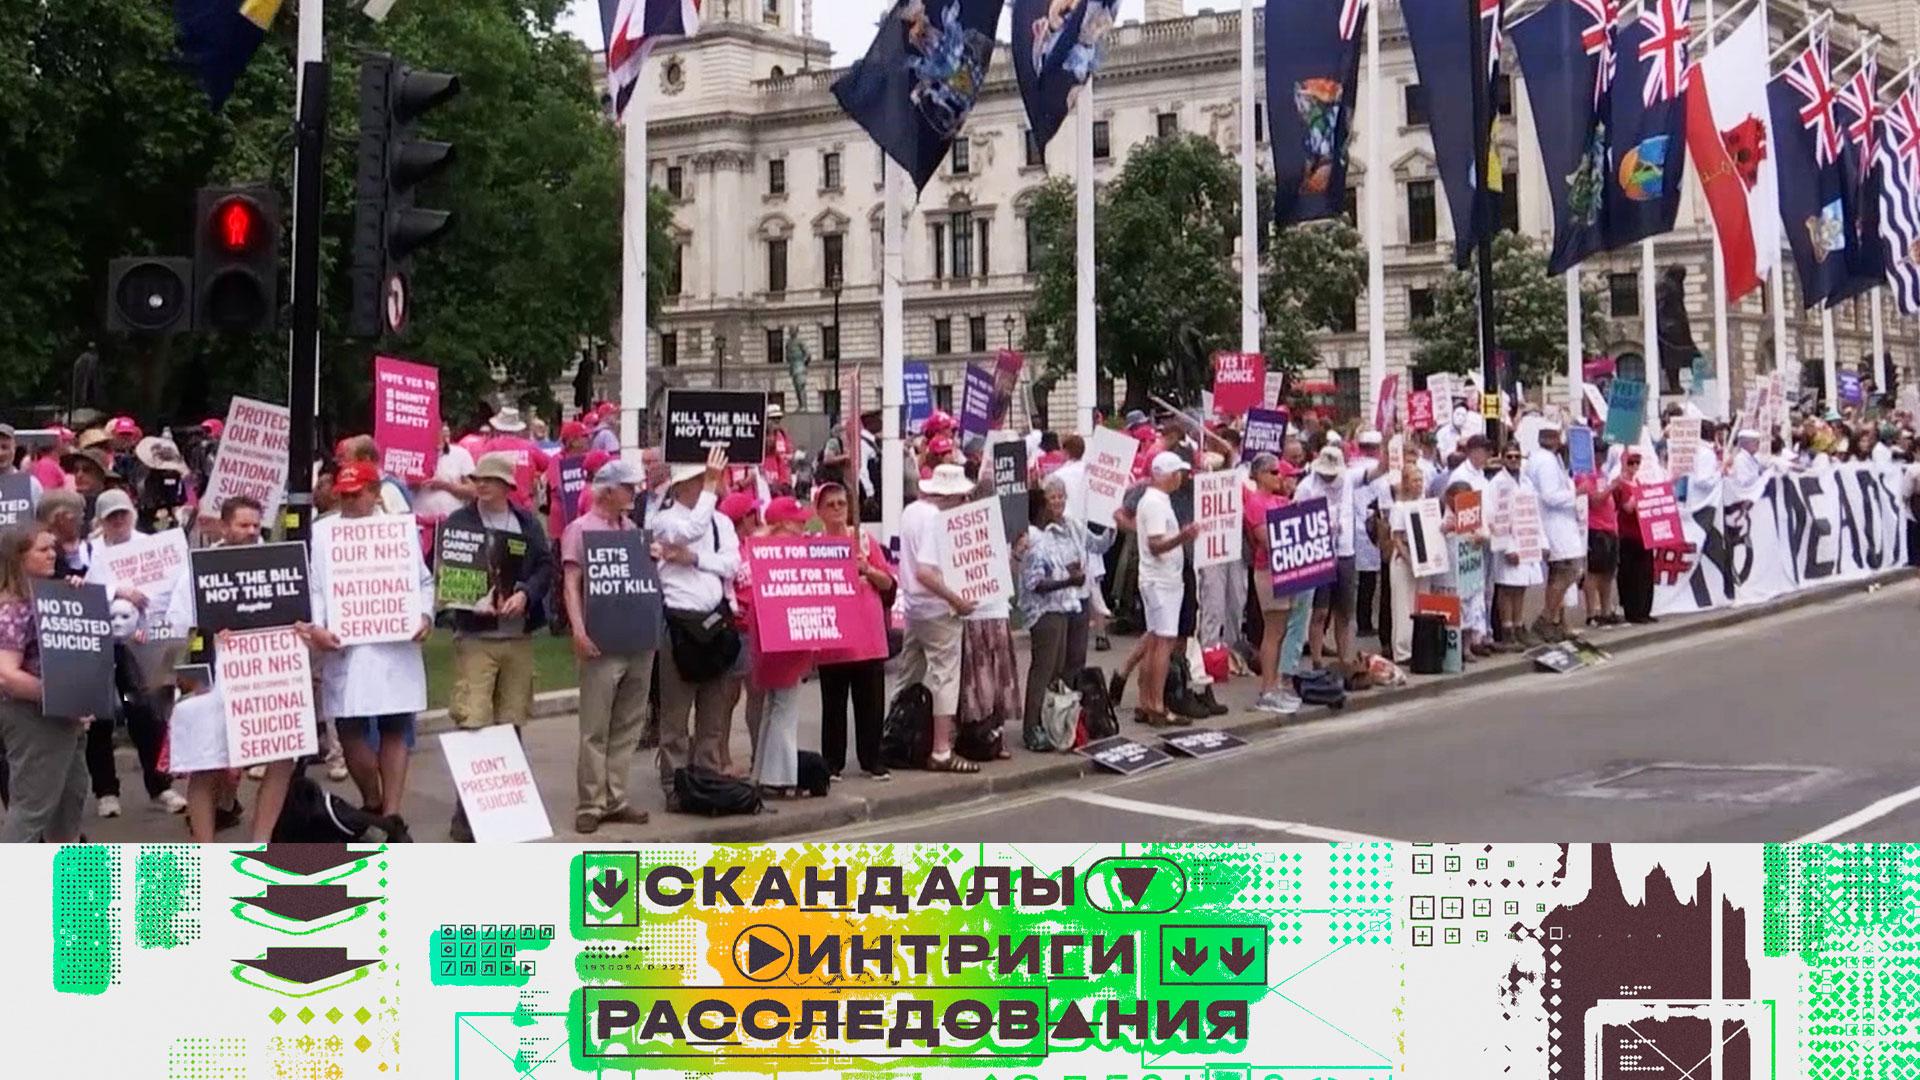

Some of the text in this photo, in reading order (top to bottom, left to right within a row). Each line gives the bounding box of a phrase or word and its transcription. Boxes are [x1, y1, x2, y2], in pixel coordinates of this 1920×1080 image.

[1219, 356, 1238, 369] YES
[379, 371, 404, 385] VOTE
[234, 404, 290, 430] PROTEC
[395, 414, 430, 428] SAFETY
[671, 411, 760, 425] KILL THE BILL
[228, 424, 259, 445] OUR
[674, 425, 755, 438] NOT THE ILL
[219, 458, 282, 485] NATIONAL
[219, 478, 273, 502] SUICIDE
[0, 499, 30, 512] TED
[1201, 491, 1237, 518] BILL
[947, 507, 991, 533] ASSIST
[1268, 509, 1330, 549] LET US
[331, 521, 409, 542] PROTECT
[955, 527, 989, 549] US IN
[331, 542, 411, 563] OUR NHS
[587, 547, 629, 562] LET'S
[752, 545, 851, 560] VOTE FOR DIGNITY
[1206, 535, 1229, 560] ILL
[1271, 536, 1333, 573] CHOOSE
[198, 567, 303, 589] KILL THE BILL
[588, 564, 631, 579] CARE
[768, 568, 798, 582] VOTE
[800, 568, 823, 581] FOR
[823, 568, 845, 580] THE
[965, 563, 990, 582] NOT
[205, 582, 300, 604] NOT THE ILL
[333, 577, 413, 598] NATIONAL
[589, 579, 658, 596] NOT KILL
[760, 583, 856, 597] LEADBEATER BILL
[961, 579, 1000, 601] DYING
[38, 598, 83, 616] NO TO
[341, 597, 408, 618] SUICIDE
[41, 617, 110, 640] ASSISTED
[340, 618, 411, 638] SERVICE
[788, 613, 837, 629] DIGNITY
[43, 634, 102, 652] SUICIDE
[227, 631, 299, 655] PROTECT
[268, 652, 303, 673] NHS
[231, 691, 307, 717] NATIONAL
[240, 712, 303, 737] SUICIDE
[241, 733, 306, 759] SERVICE
[470, 756, 508, 775] DON'T
[461, 771, 531, 794] PRESCRIBE
[477, 790, 528, 812] SUICIDE
